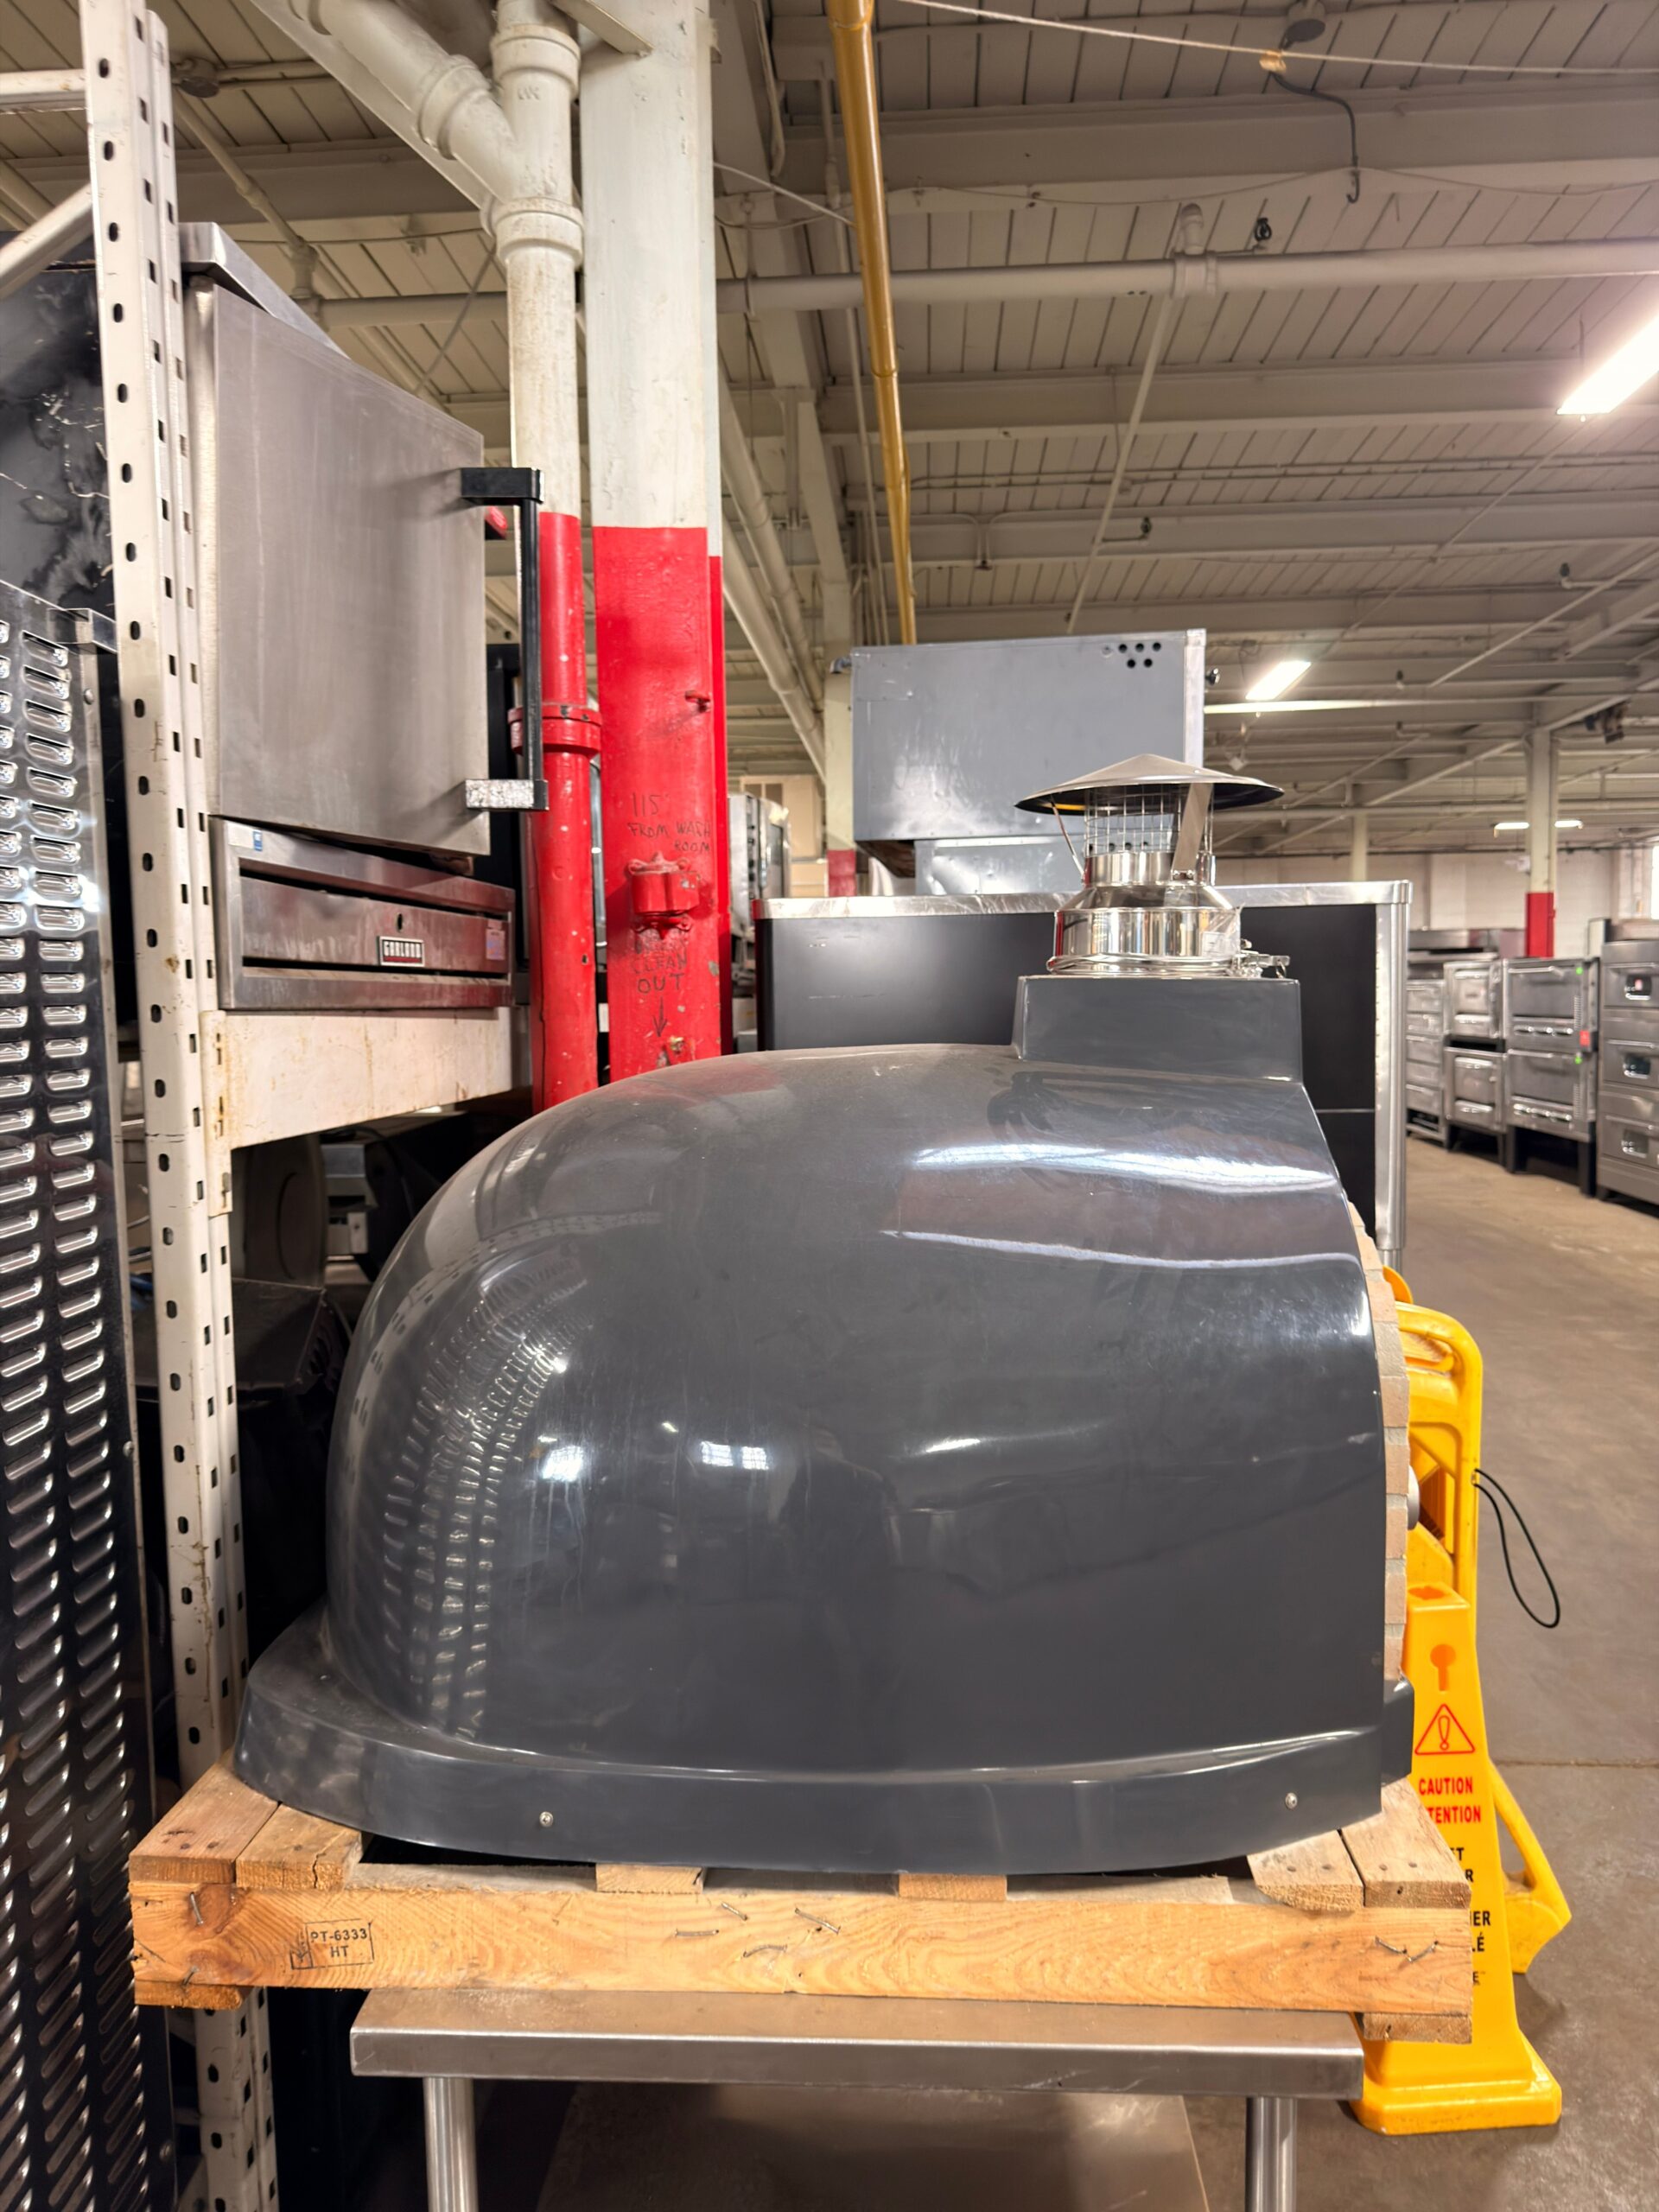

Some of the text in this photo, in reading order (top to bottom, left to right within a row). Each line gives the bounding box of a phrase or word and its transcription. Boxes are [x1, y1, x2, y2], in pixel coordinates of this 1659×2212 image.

[626, 820, 711, 838] FROM WASH
[674, 839, 710, 854] ROOM
[637, 973, 684, 994] OUT
[1418, 1777, 1473, 1796] CAUTION
[1427, 1805, 1481, 1824] TENTION
[310, 1928, 367, 1942] PT-6333
[330, 1945, 349, 1958] HT
